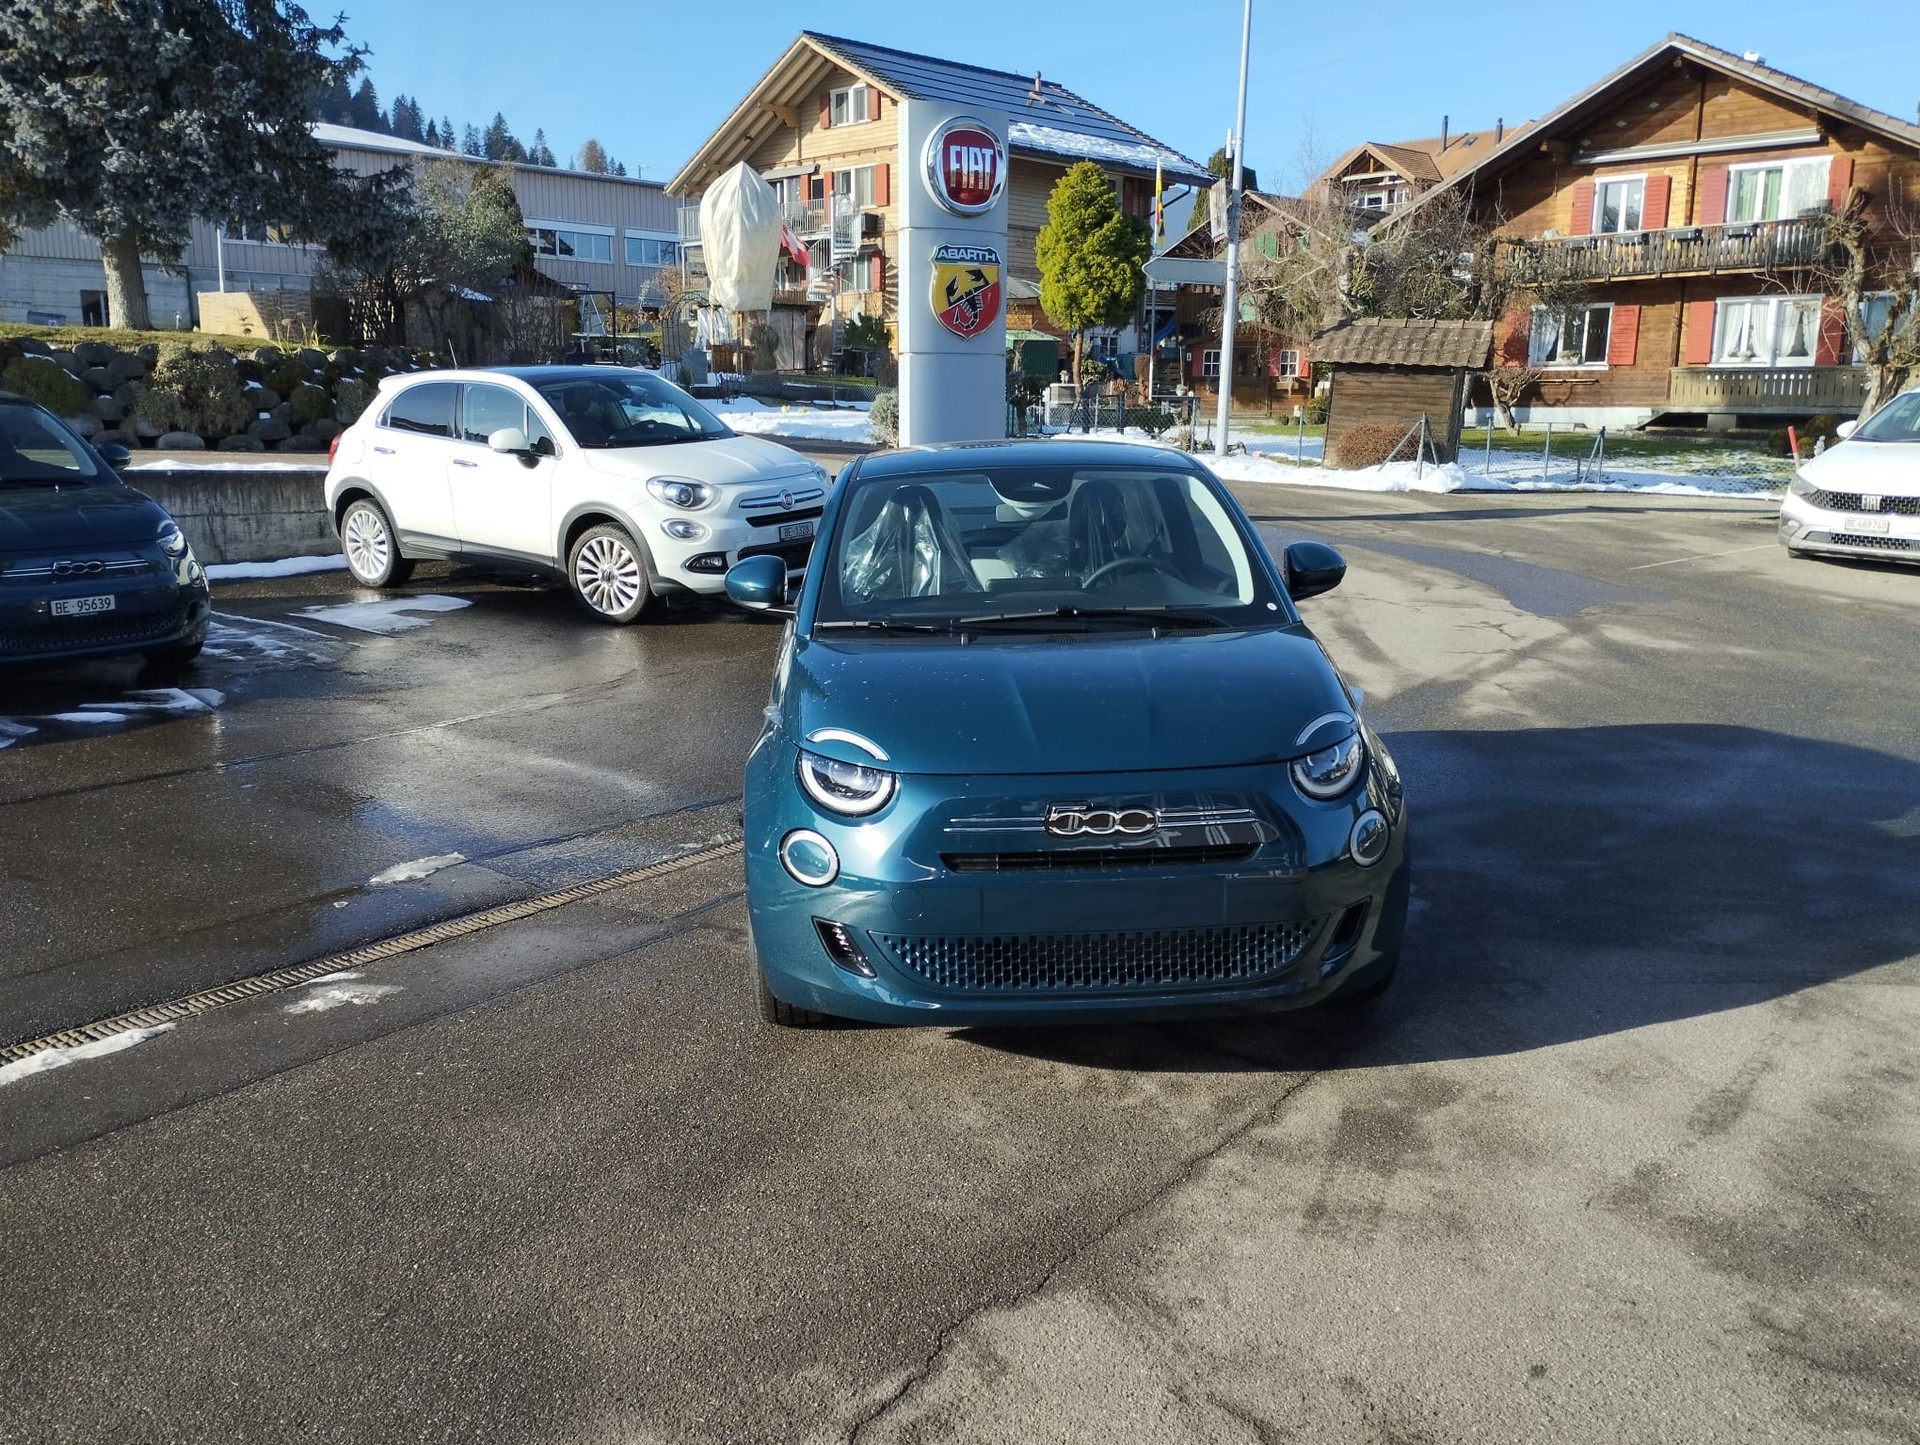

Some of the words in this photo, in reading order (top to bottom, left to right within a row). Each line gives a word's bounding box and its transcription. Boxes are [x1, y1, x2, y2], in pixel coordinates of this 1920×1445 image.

[949, 145, 995, 190] FIAT
[937, 248, 996, 262] ABARTH
[1861, 495, 1882, 510] FIAT
[53, 560, 104, 576] 500
[55, 601, 70, 614] BE
[77, 597, 111, 612] 95639
[1048, 804, 1156, 836] 500
